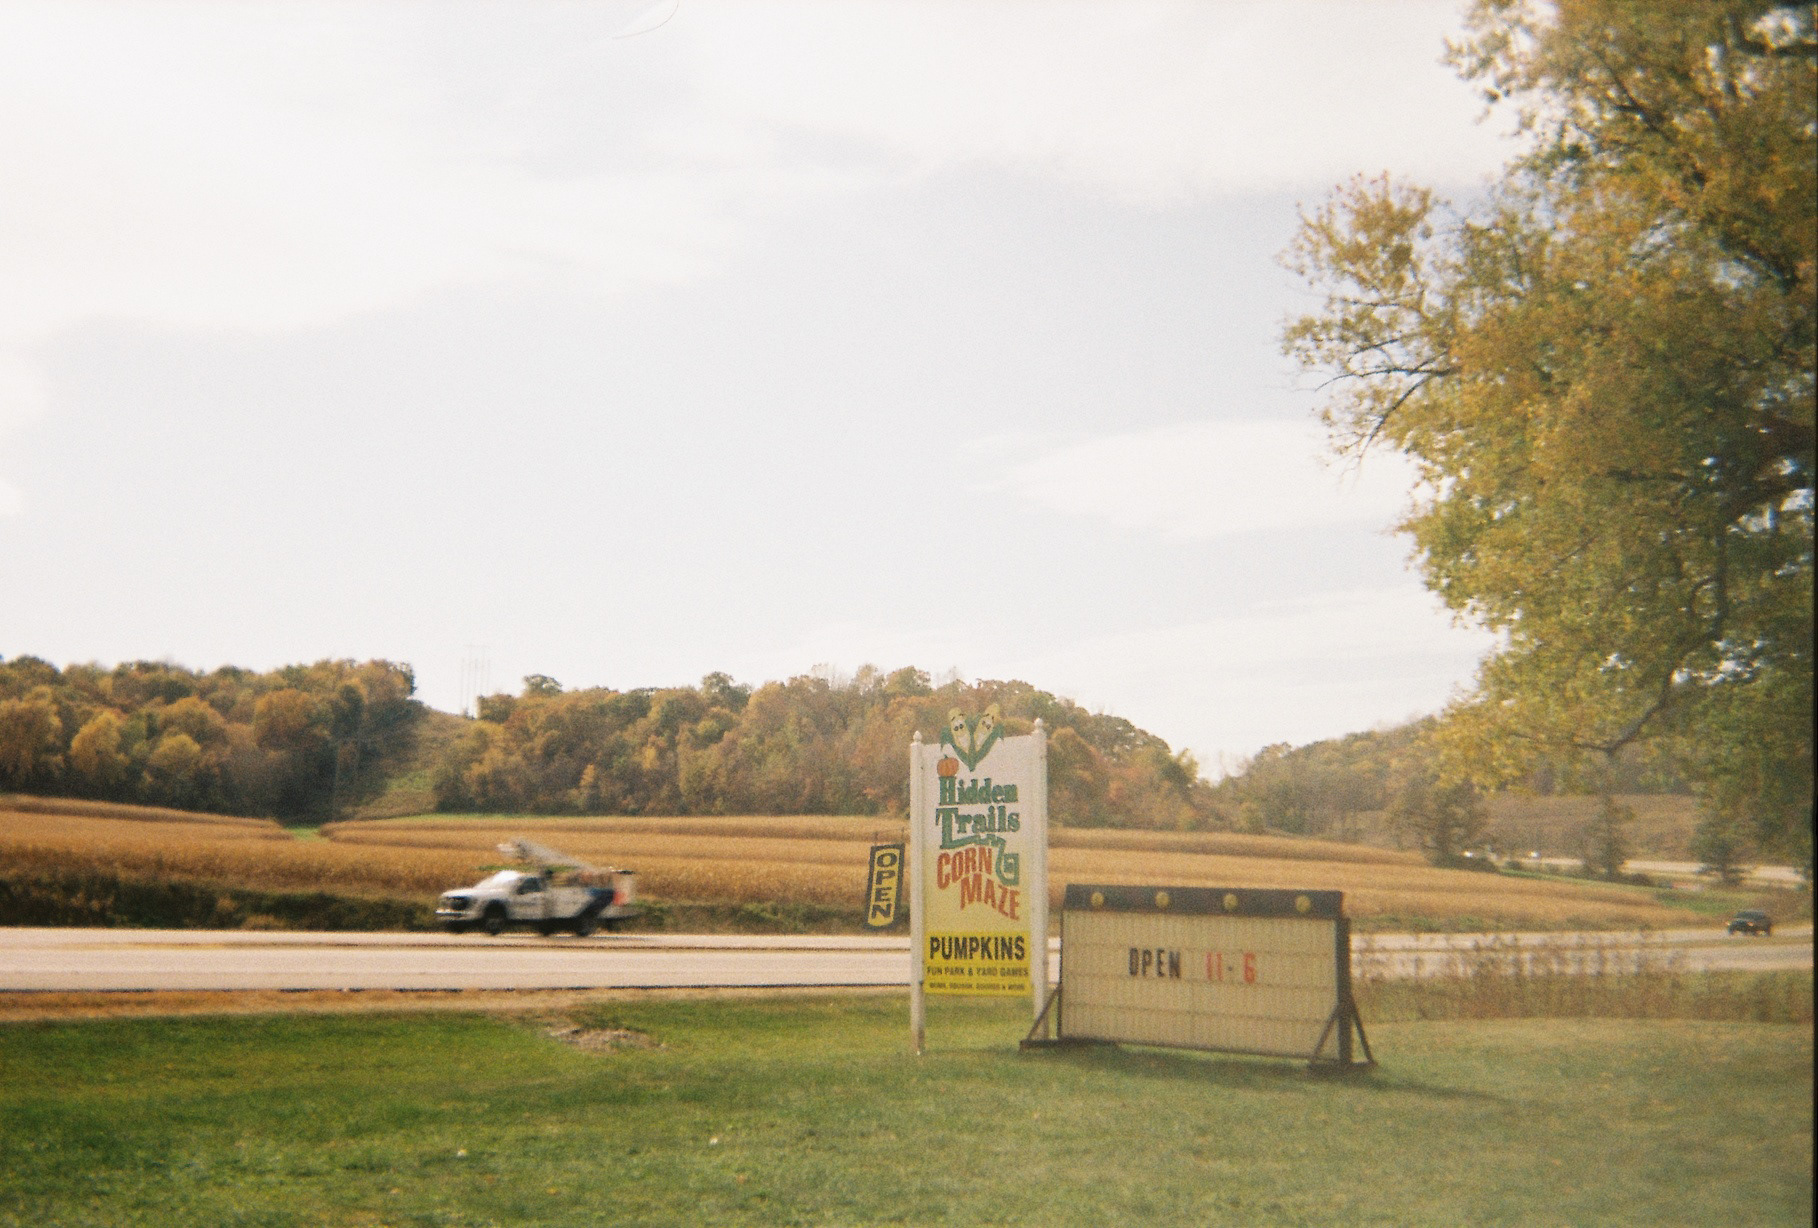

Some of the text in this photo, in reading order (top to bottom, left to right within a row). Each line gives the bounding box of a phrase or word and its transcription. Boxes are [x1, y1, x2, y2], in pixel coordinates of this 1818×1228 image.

[939, 776, 1019, 805] Hidden
[936, 806, 1020, 849] Trails
[871, 852, 898, 919] OPEN
[937, 847, 992, 890] CORN
[960, 873, 1020, 920] MAZE
[929, 935, 1025, 960] PUMPKINS
[1129, 948, 1181, 979] OPEN
[926, 966, 942, 976] FUN
[944, 966, 965, 976] PARK
[976, 967, 998, 977] YARD
[1000, 967, 1029, 977] GAMES
